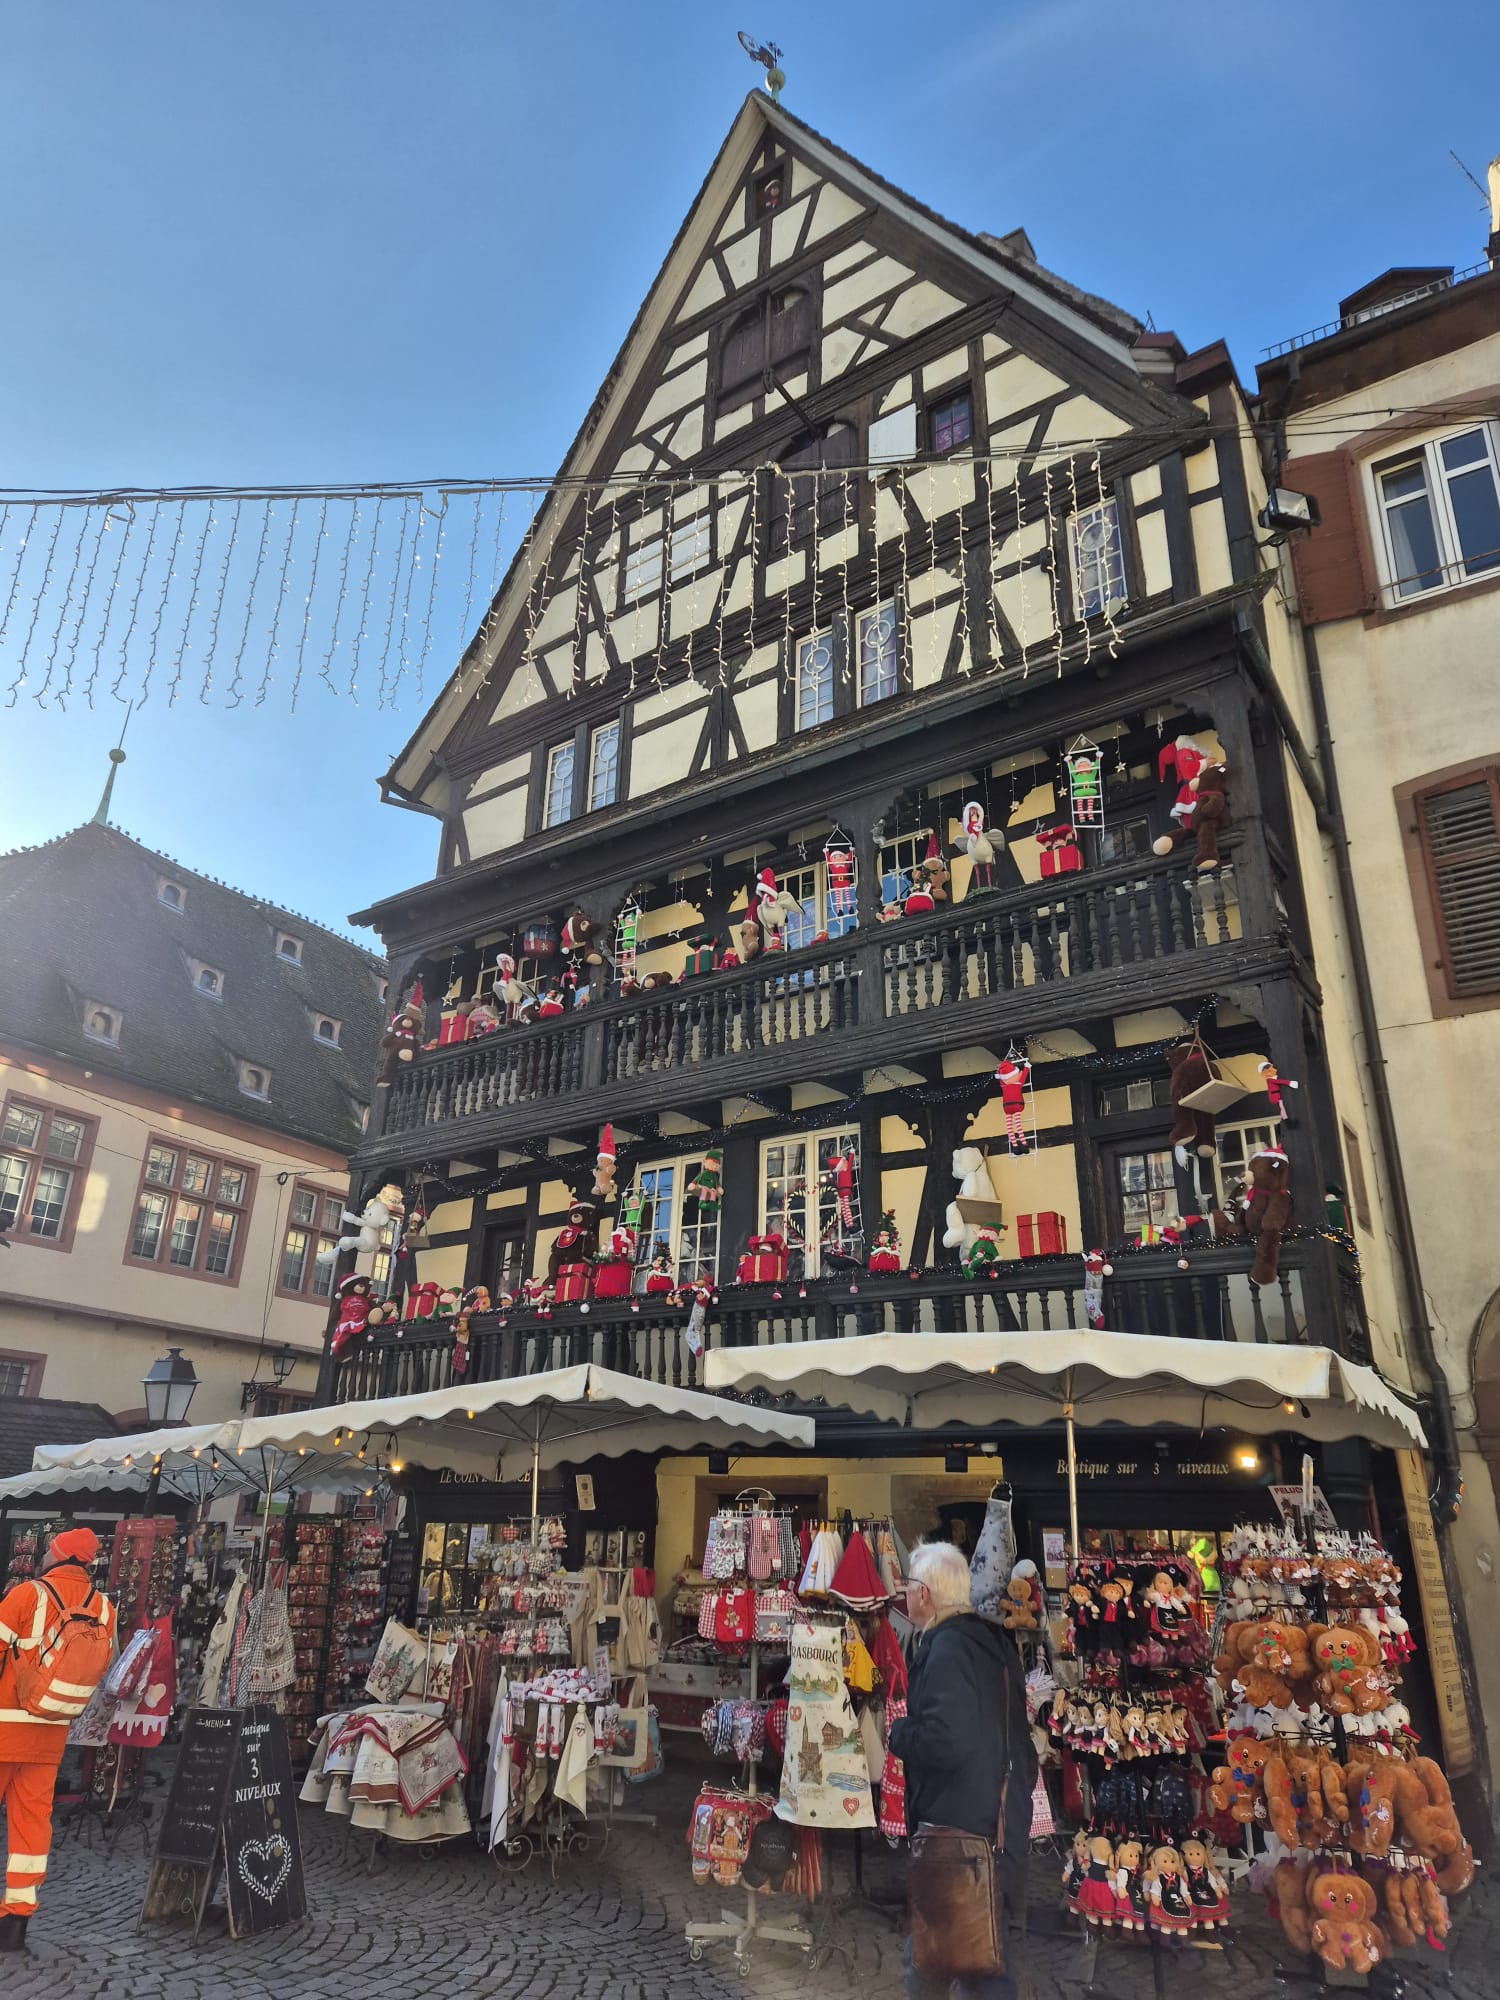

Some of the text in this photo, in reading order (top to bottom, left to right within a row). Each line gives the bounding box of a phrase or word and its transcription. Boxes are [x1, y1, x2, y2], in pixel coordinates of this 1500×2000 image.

[1116, 1462, 1138, 1475] sur
[1153, 1462, 1160, 1475] 3
[1177, 1458, 1230, 1475] niveaux
[246, 1743, 261, 1754] sur
[250, 1757, 259, 1779] 3
[235, 1783, 281, 1803] NIVEAUX
